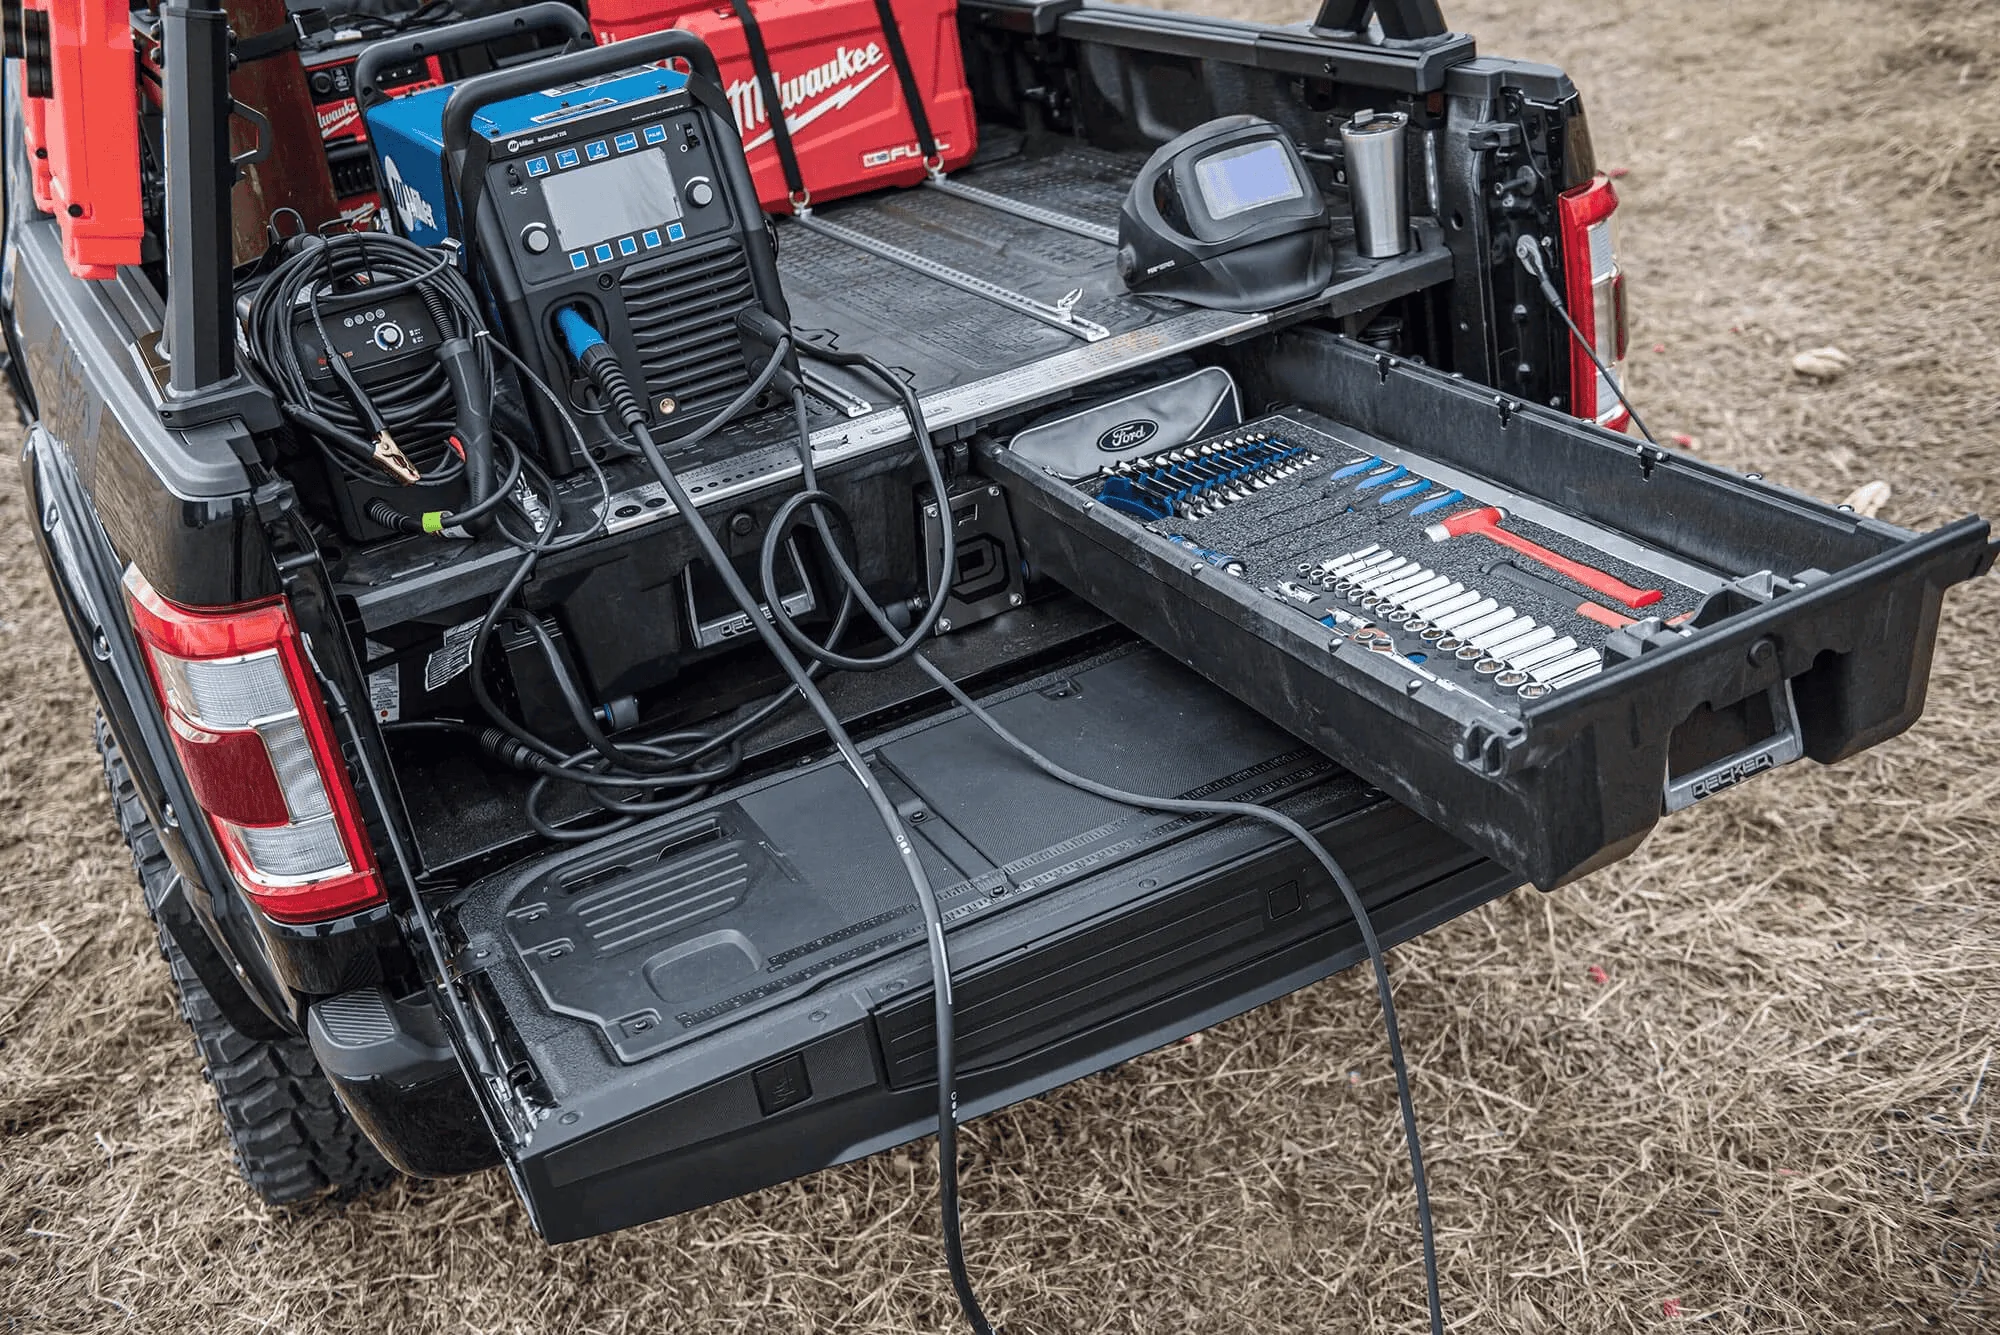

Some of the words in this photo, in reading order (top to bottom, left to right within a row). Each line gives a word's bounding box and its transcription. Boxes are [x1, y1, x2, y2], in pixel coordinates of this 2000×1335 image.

[726, 42, 884, 137] Mwaukee
[317, 99, 358, 129] lwauke
[891, 138, 950, 161] FUL
[1112, 425, 1146, 447] Ford
[721, 603, 792, 634] DECE
[1691, 752, 1774, 798] DECKED
